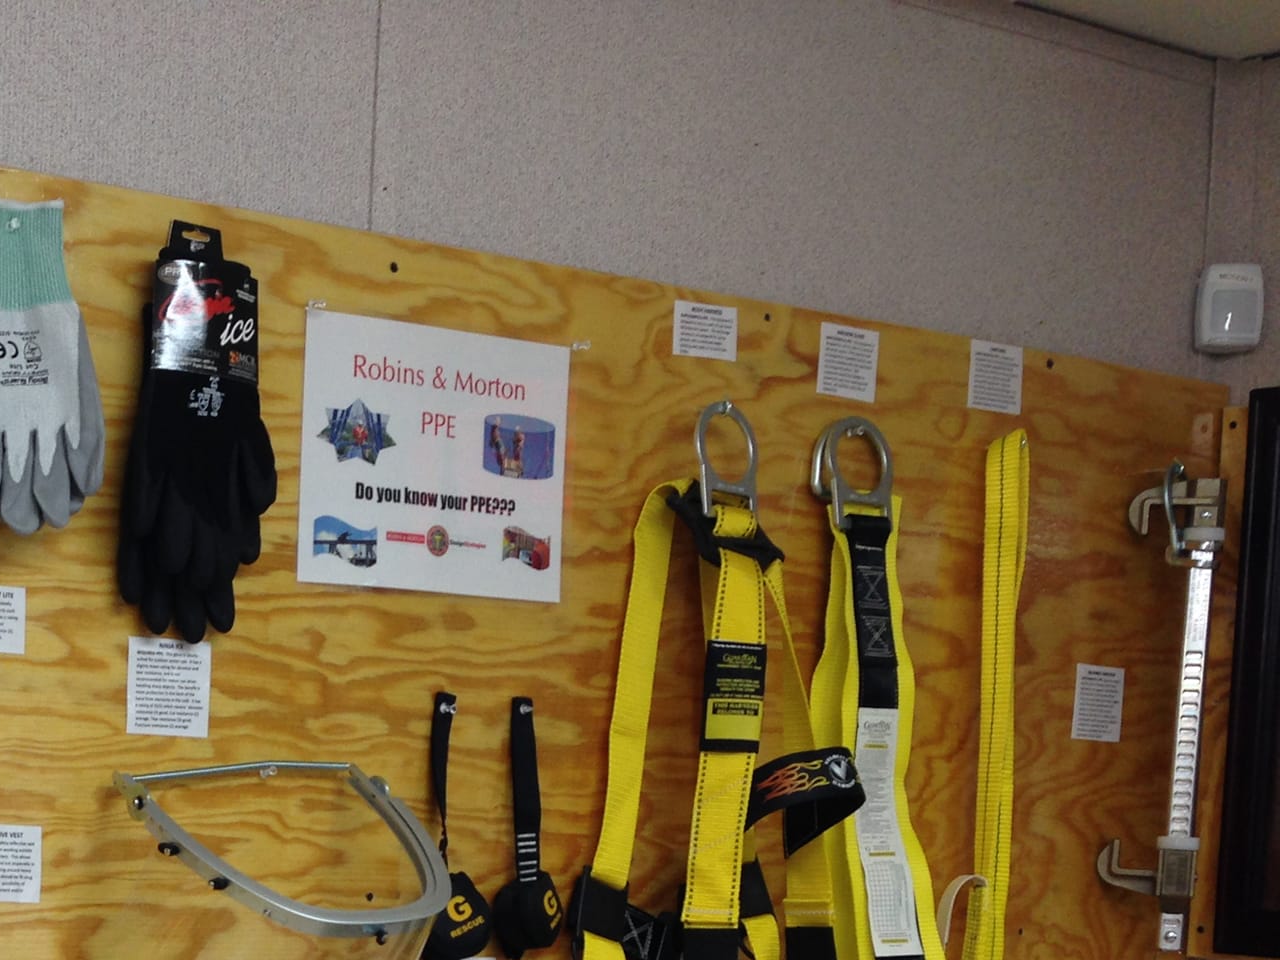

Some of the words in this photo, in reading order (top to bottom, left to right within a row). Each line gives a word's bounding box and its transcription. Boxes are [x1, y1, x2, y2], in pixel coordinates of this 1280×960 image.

[221, 314, 255, 346] ice
[353, 354, 424, 386] Robins
[432, 366, 447, 390] &
[454, 370, 526, 401] Morton
[422, 411, 456, 438] PPE
[355, 482, 373, 500] Do
[377, 485, 401, 503] you
[404, 487, 438, 507] know
[440, 493, 468, 511] your
[471, 495, 516, 516] PPE???
[447, 895, 472, 922] G
[544, 890, 557, 916] G
[450, 915, 485, 938] RESCUE
